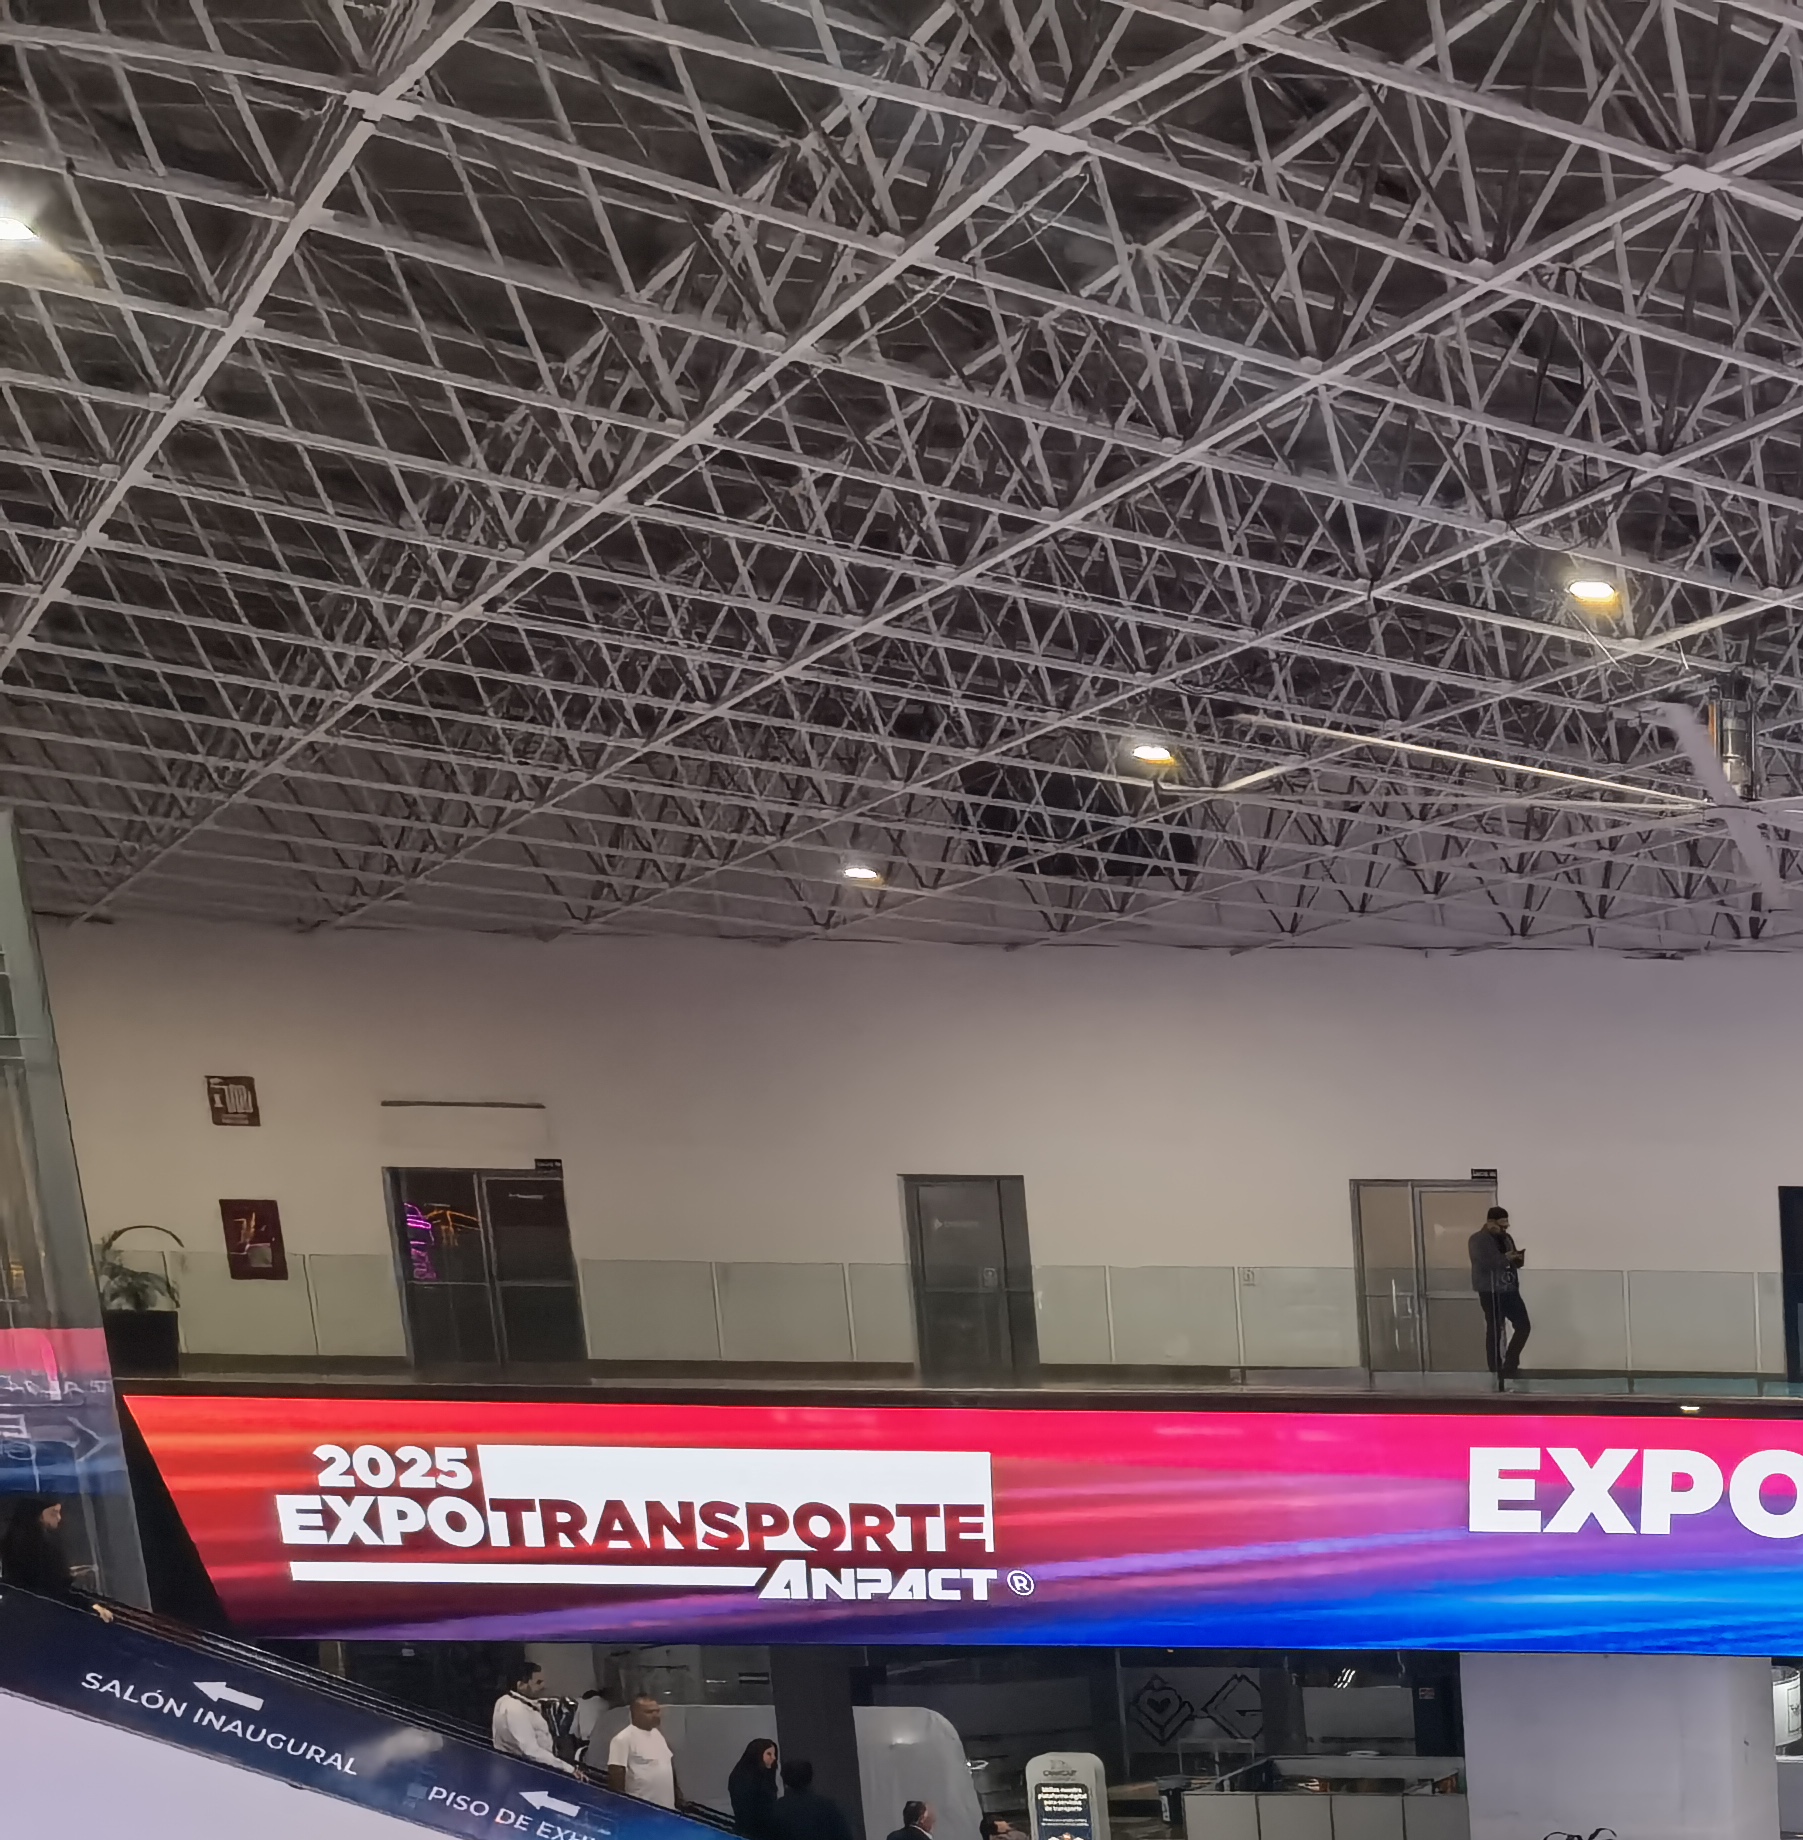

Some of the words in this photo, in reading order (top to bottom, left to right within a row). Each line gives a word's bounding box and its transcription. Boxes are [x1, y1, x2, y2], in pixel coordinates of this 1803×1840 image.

[313, 1443, 474, 1490] 2025
[277, 1494, 992, 1554] EXPOTRANSPORTE
[756, 1557, 1000, 1602] ANPACT
[80, 1671, 184, 1720] SALÓN
[192, 1706, 360, 1777] INAUGURAL
[427, 1784, 491, 1820] PISO
[494, 1806, 530, 1833] DE
